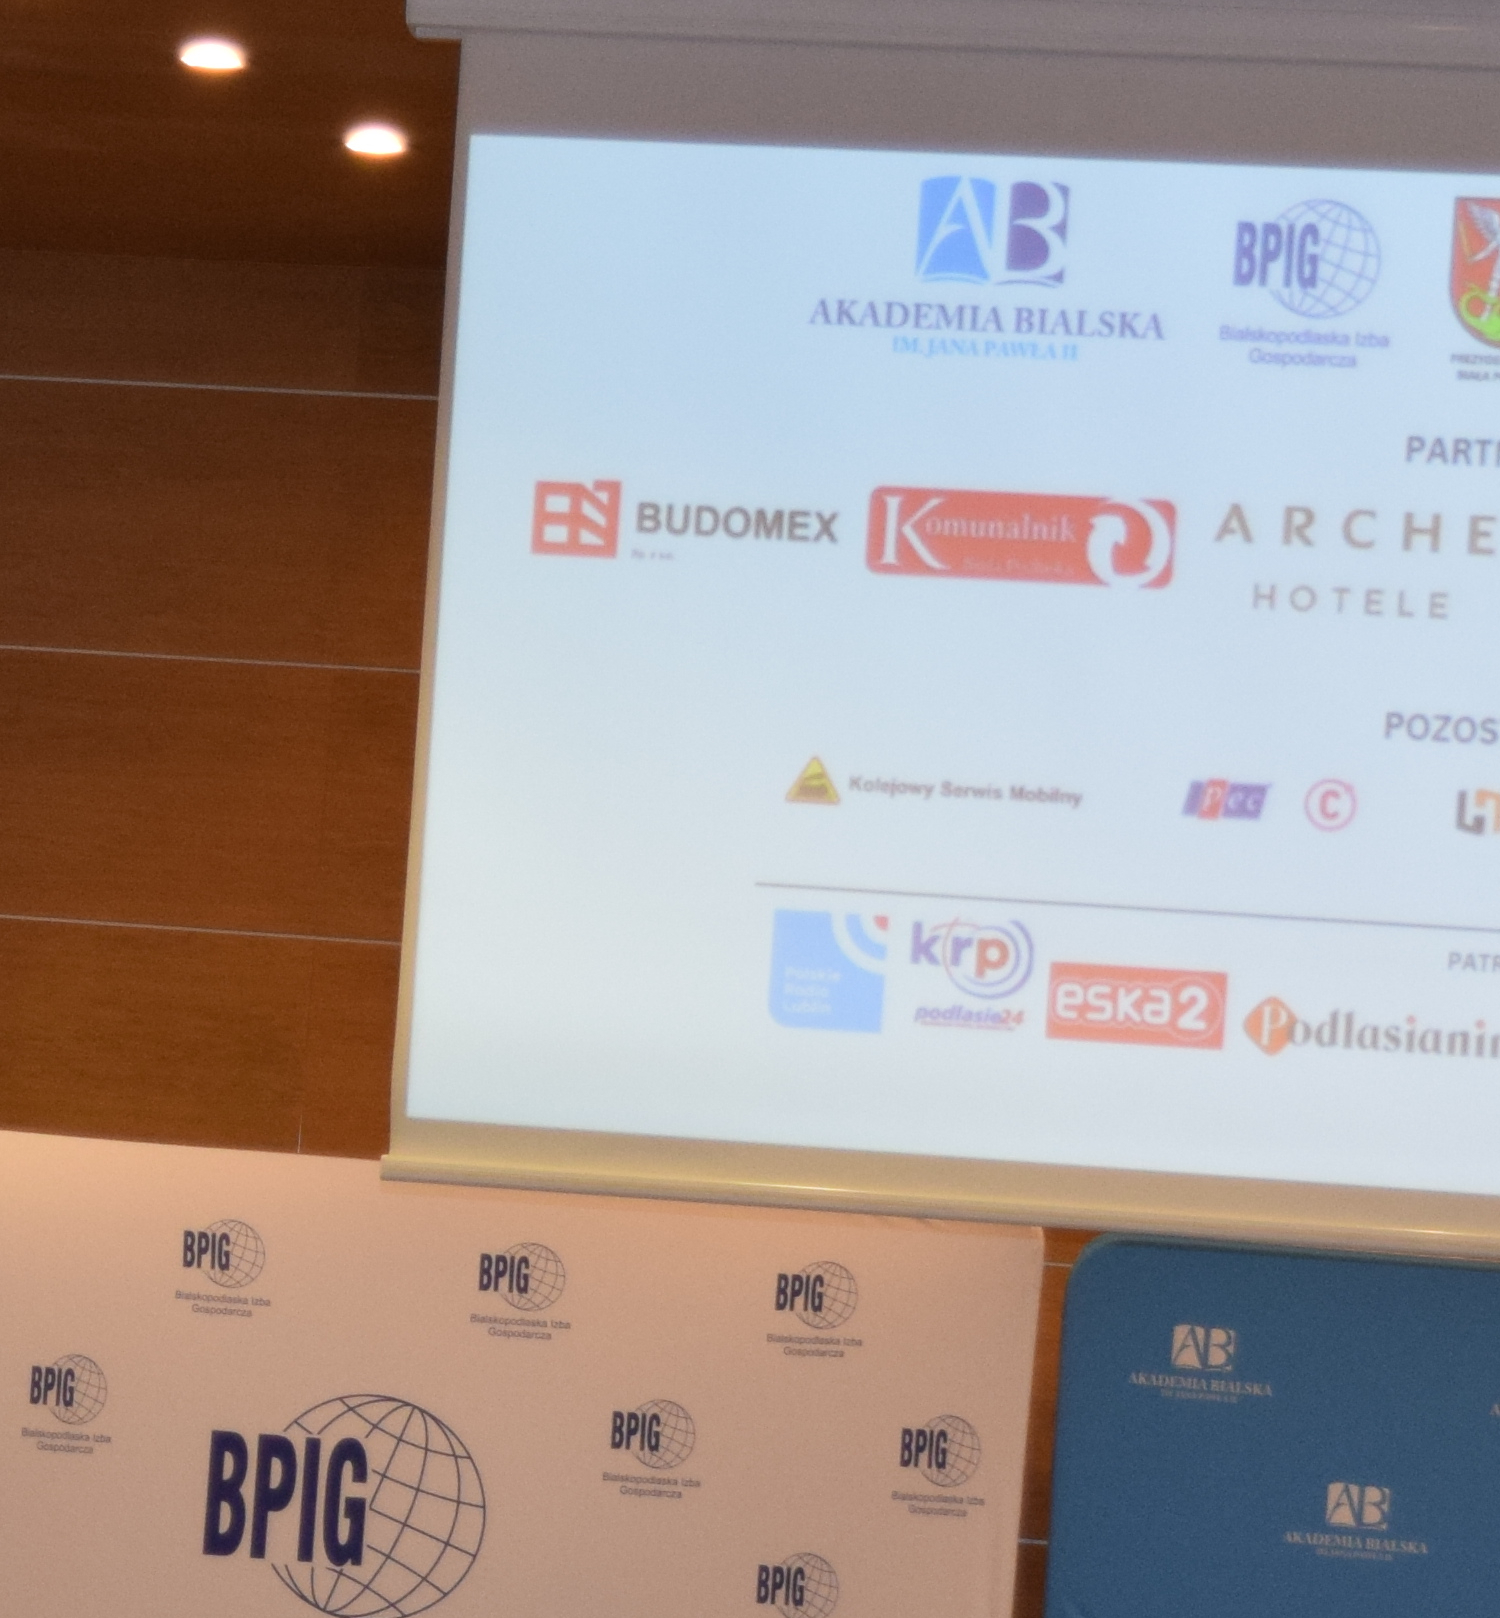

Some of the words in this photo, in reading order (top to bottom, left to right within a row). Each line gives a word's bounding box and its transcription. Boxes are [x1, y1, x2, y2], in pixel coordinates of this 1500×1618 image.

[1234, 221, 1319, 288] BPIG
[808, 299, 1004, 333] AKADEMIA
[1014, 307, 1165, 341] BIALSKA
[1355, 331, 1391, 348] Izba
[925, 337, 980, 359] JANA
[1248, 348, 1357, 368] Gospodarcza
[636, 501, 839, 544] BUDOMEX
[880, 495, 1077, 570] Komunalnik
[1215, 503, 1498, 556] ARCHE
[1251, 582, 1450, 621] HOTELE
[847, 775, 934, 799] Kolejowy
[939, 780, 1003, 801] Serwis
[1009, 784, 1084, 808] Mobilny
[910, 920, 1011, 979] krp
[914, 1004, 1025, 1026] podlasie24
[1055, 981, 1209, 1031] eska2
[182, 1230, 231, 1271] BPIG
[478, 1252, 529, 1295] BPIG
[775, 1273, 824, 1314] BPIG
[29, 1365, 76, 1408] BPIG
[1128, 1370, 1207, 1393] AKADEMIA
[1210, 1375, 1272, 1397] BIALSKA
[611, 1410, 661, 1454] BPIG
[900, 1427, 948, 1471] BPIG
[202, 1430, 368, 1567] BPIG
[1282, 1530, 1362, 1550] AKADEMIA
[1366, 1534, 1428, 1555] BIALSKA
[756, 1564, 805, 1608] BPIG
